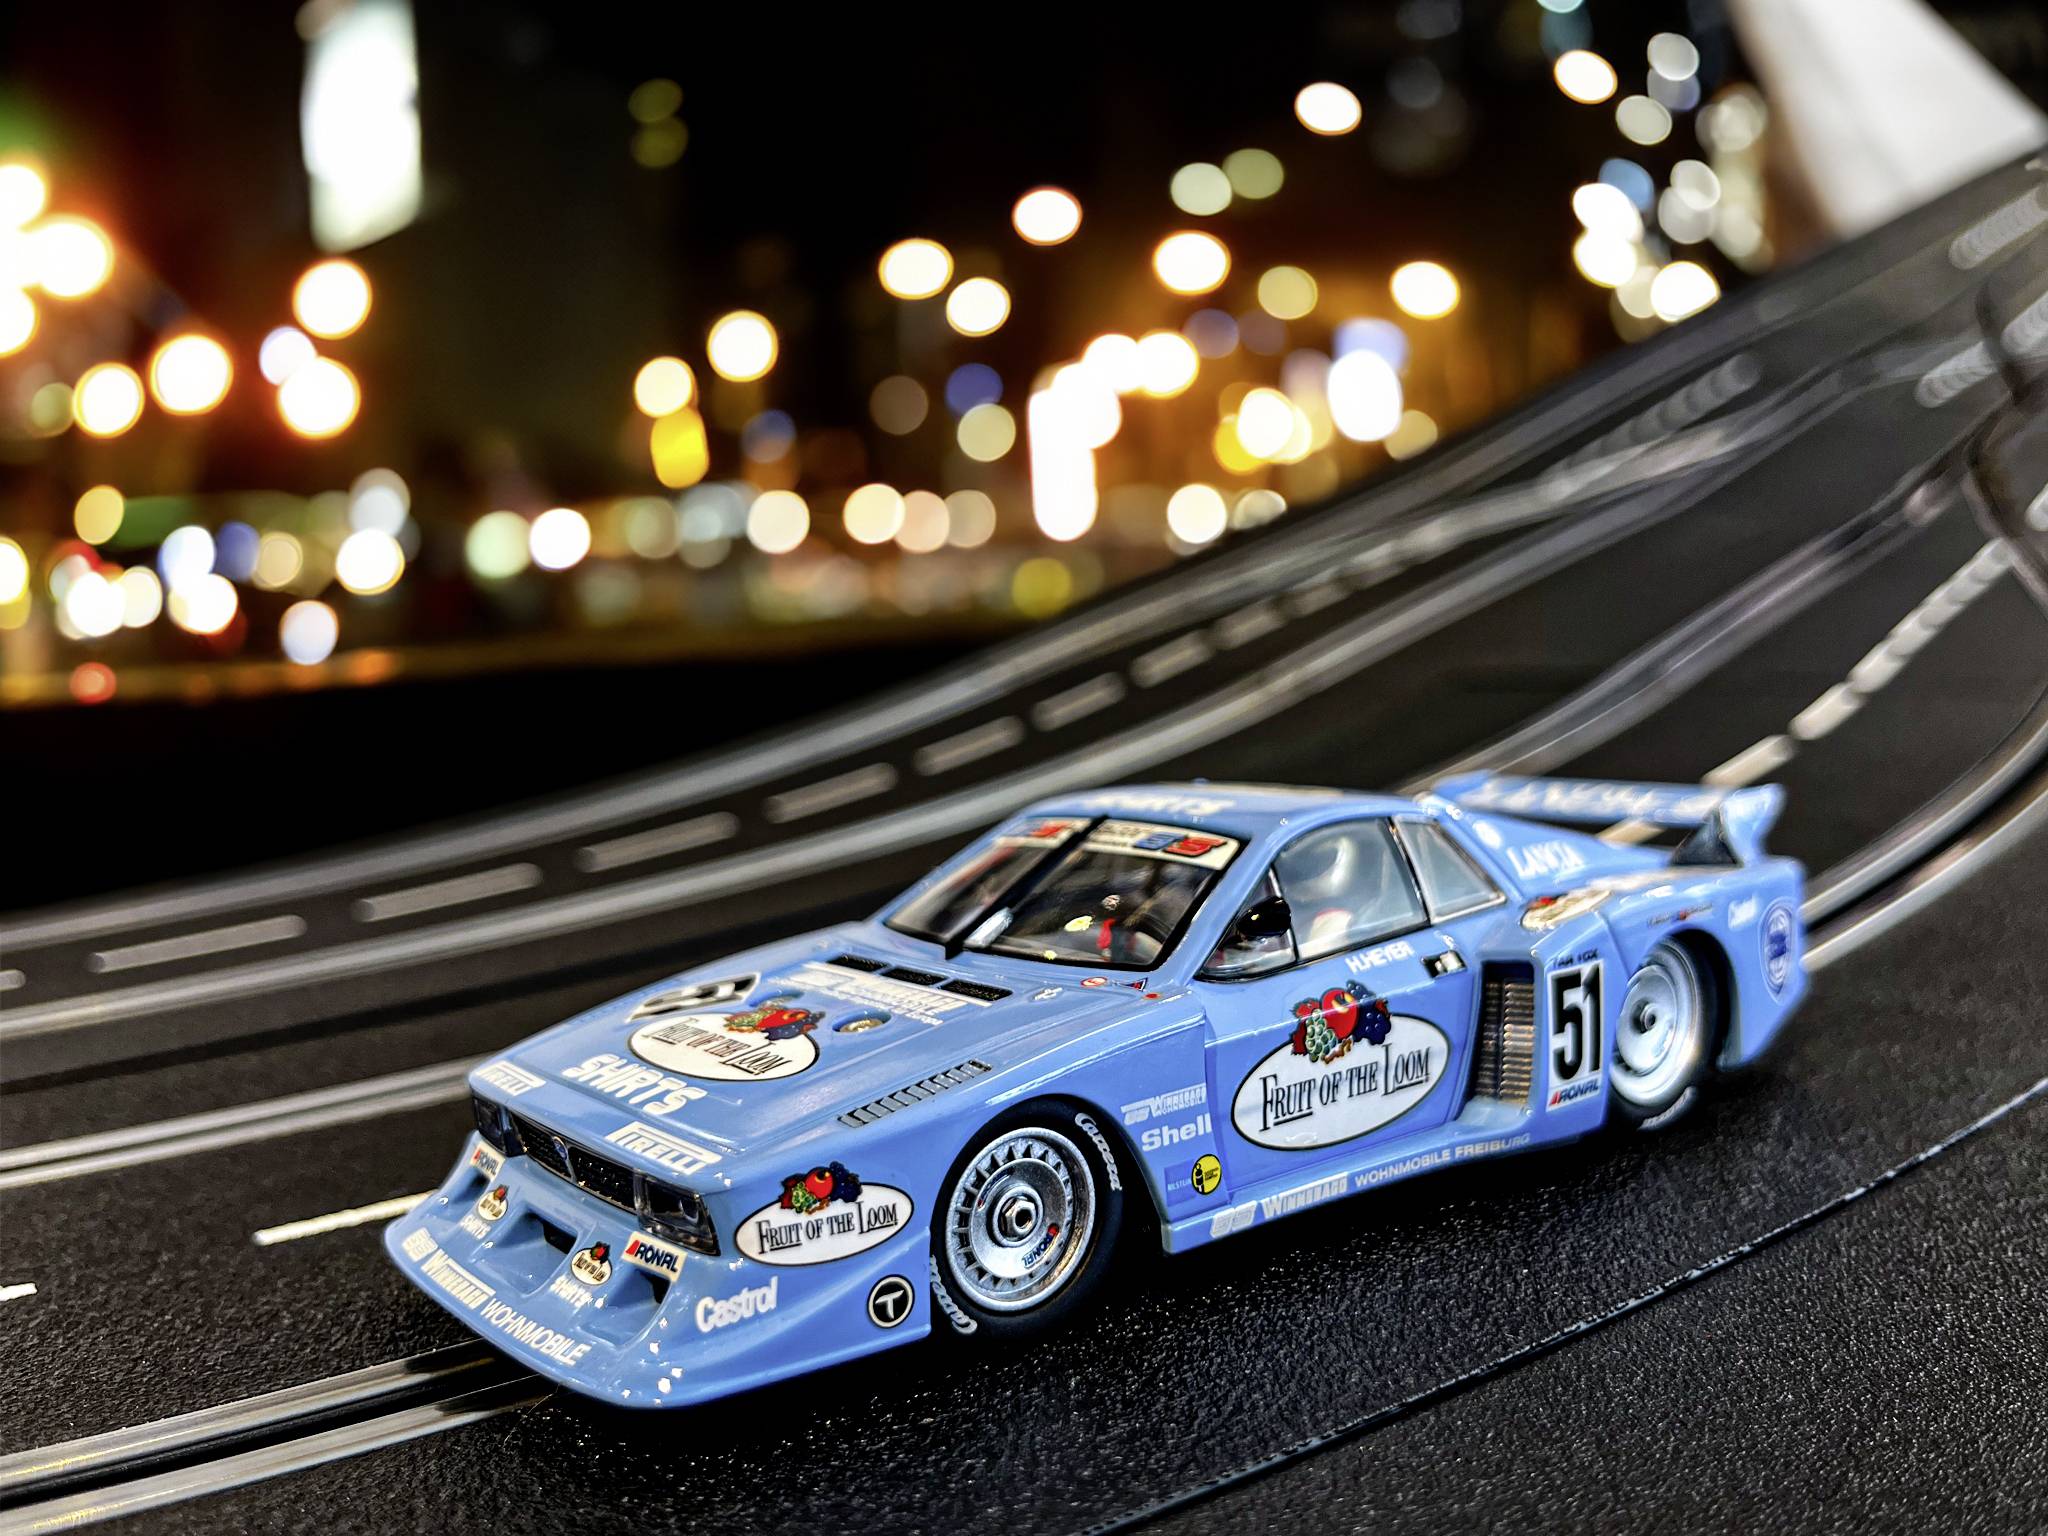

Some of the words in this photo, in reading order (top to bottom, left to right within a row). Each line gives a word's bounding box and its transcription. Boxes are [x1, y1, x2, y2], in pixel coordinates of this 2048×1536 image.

[641, 1017, 706, 1045] FRUIT
[704, 1038, 752, 1057] THE
[1552, 964, 1601, 1081] 51
[475, 1060, 547, 1097] PIRELLI
[561, 1053, 708, 1116] SHIRTS
[718, 1042, 793, 1076] LOOM
[1258, 1074, 1314, 1132] FRUIT
[1319, 1069, 1343, 1106] OF
[1345, 1061, 1379, 1097] THE
[1382, 1042, 1431, 1097] LOOM
[605, 1121, 722, 1175] PIRELLI
[1141, 1113, 1212, 1152] Shell
[1354, 1149, 1451, 1188] WOHNMOBILE
[1455, 1132, 1531, 1159] FREIBURG
[756, 1219, 803, 1255] FRUIT
[805, 1219, 824, 1240] OF
[826, 1212, 855, 1236] THE
[856, 1200, 899, 1235] LOOM
[634, 1241, 680, 1273] RONAL
[480, 1298, 592, 1366] WOHNMOBILE
[695, 1276, 778, 1334] Castrol
